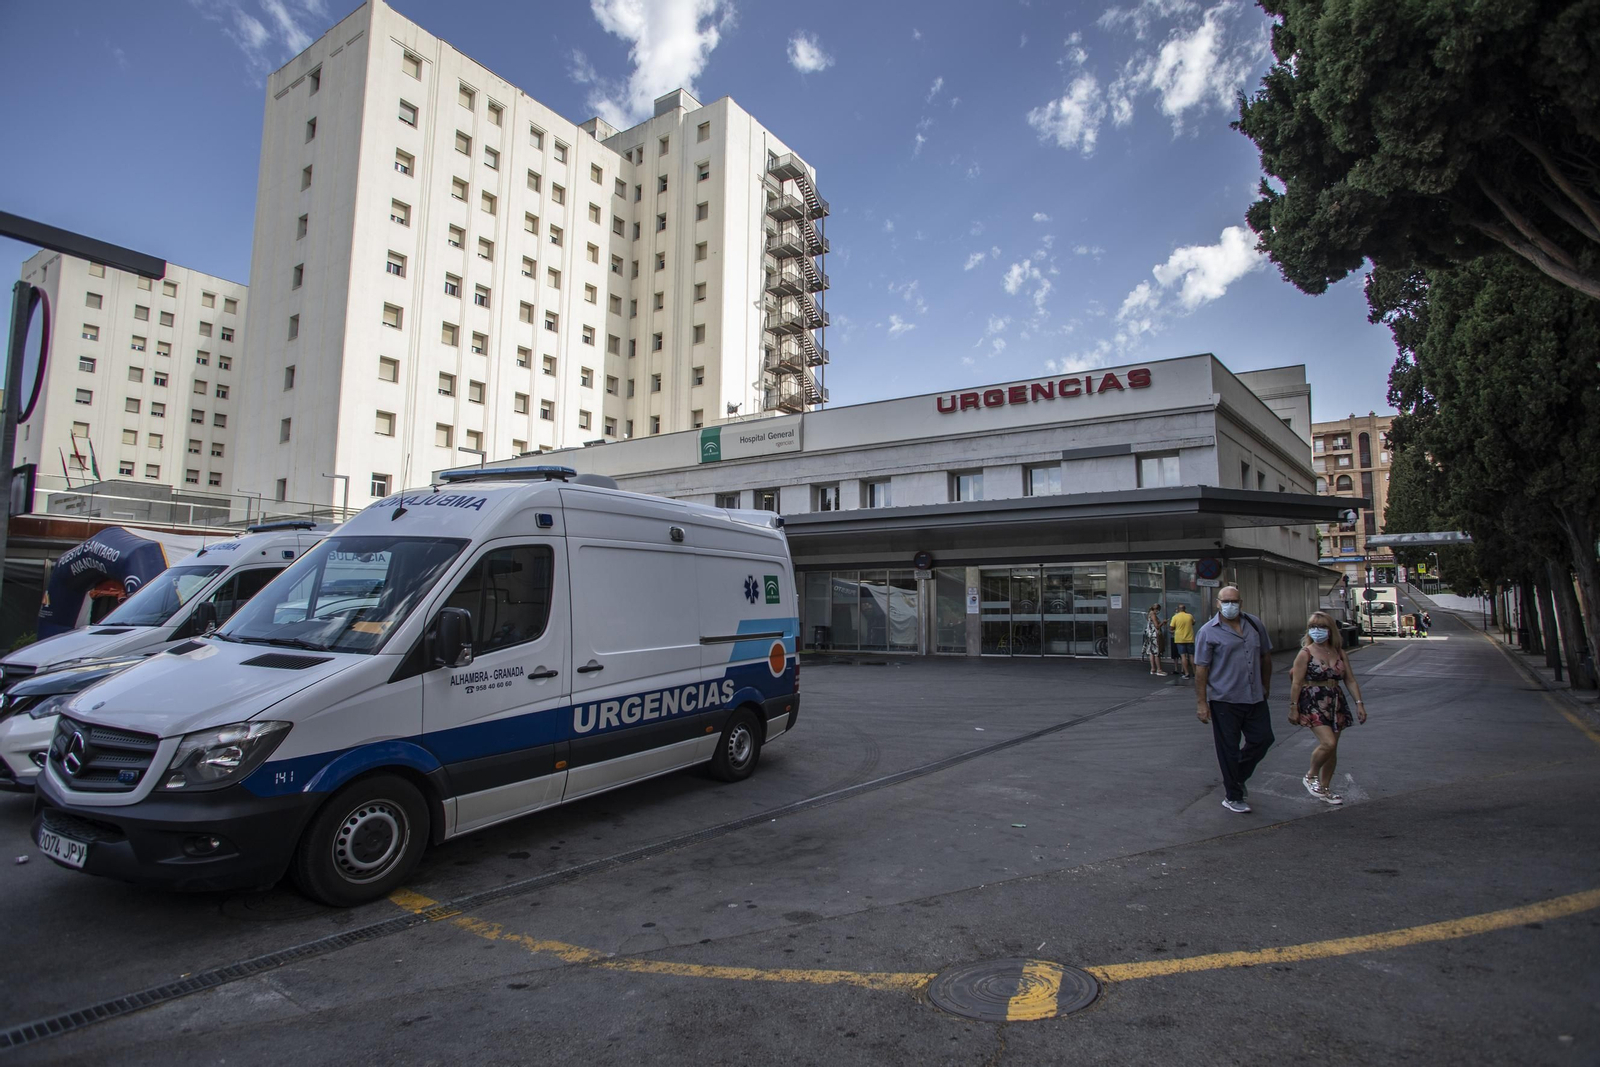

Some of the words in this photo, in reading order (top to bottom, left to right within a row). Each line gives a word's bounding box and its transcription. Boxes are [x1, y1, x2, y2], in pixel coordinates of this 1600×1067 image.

[937, 368, 1151, 414] URGENCIAS
[739, 433, 766, 444] Hospital
[767, 429, 795, 440] General
[83, 540, 121, 563] SANITARIO
[70, 557, 108, 577] AVANZADO
[450, 671, 489, 686] ALHAMBRA
[494, 666, 524, 680] GRANADA
[573, 679, 735, 734] URGENCIAS
[40, 831, 60, 856] 2074
[63, 841, 85, 863] JPY
